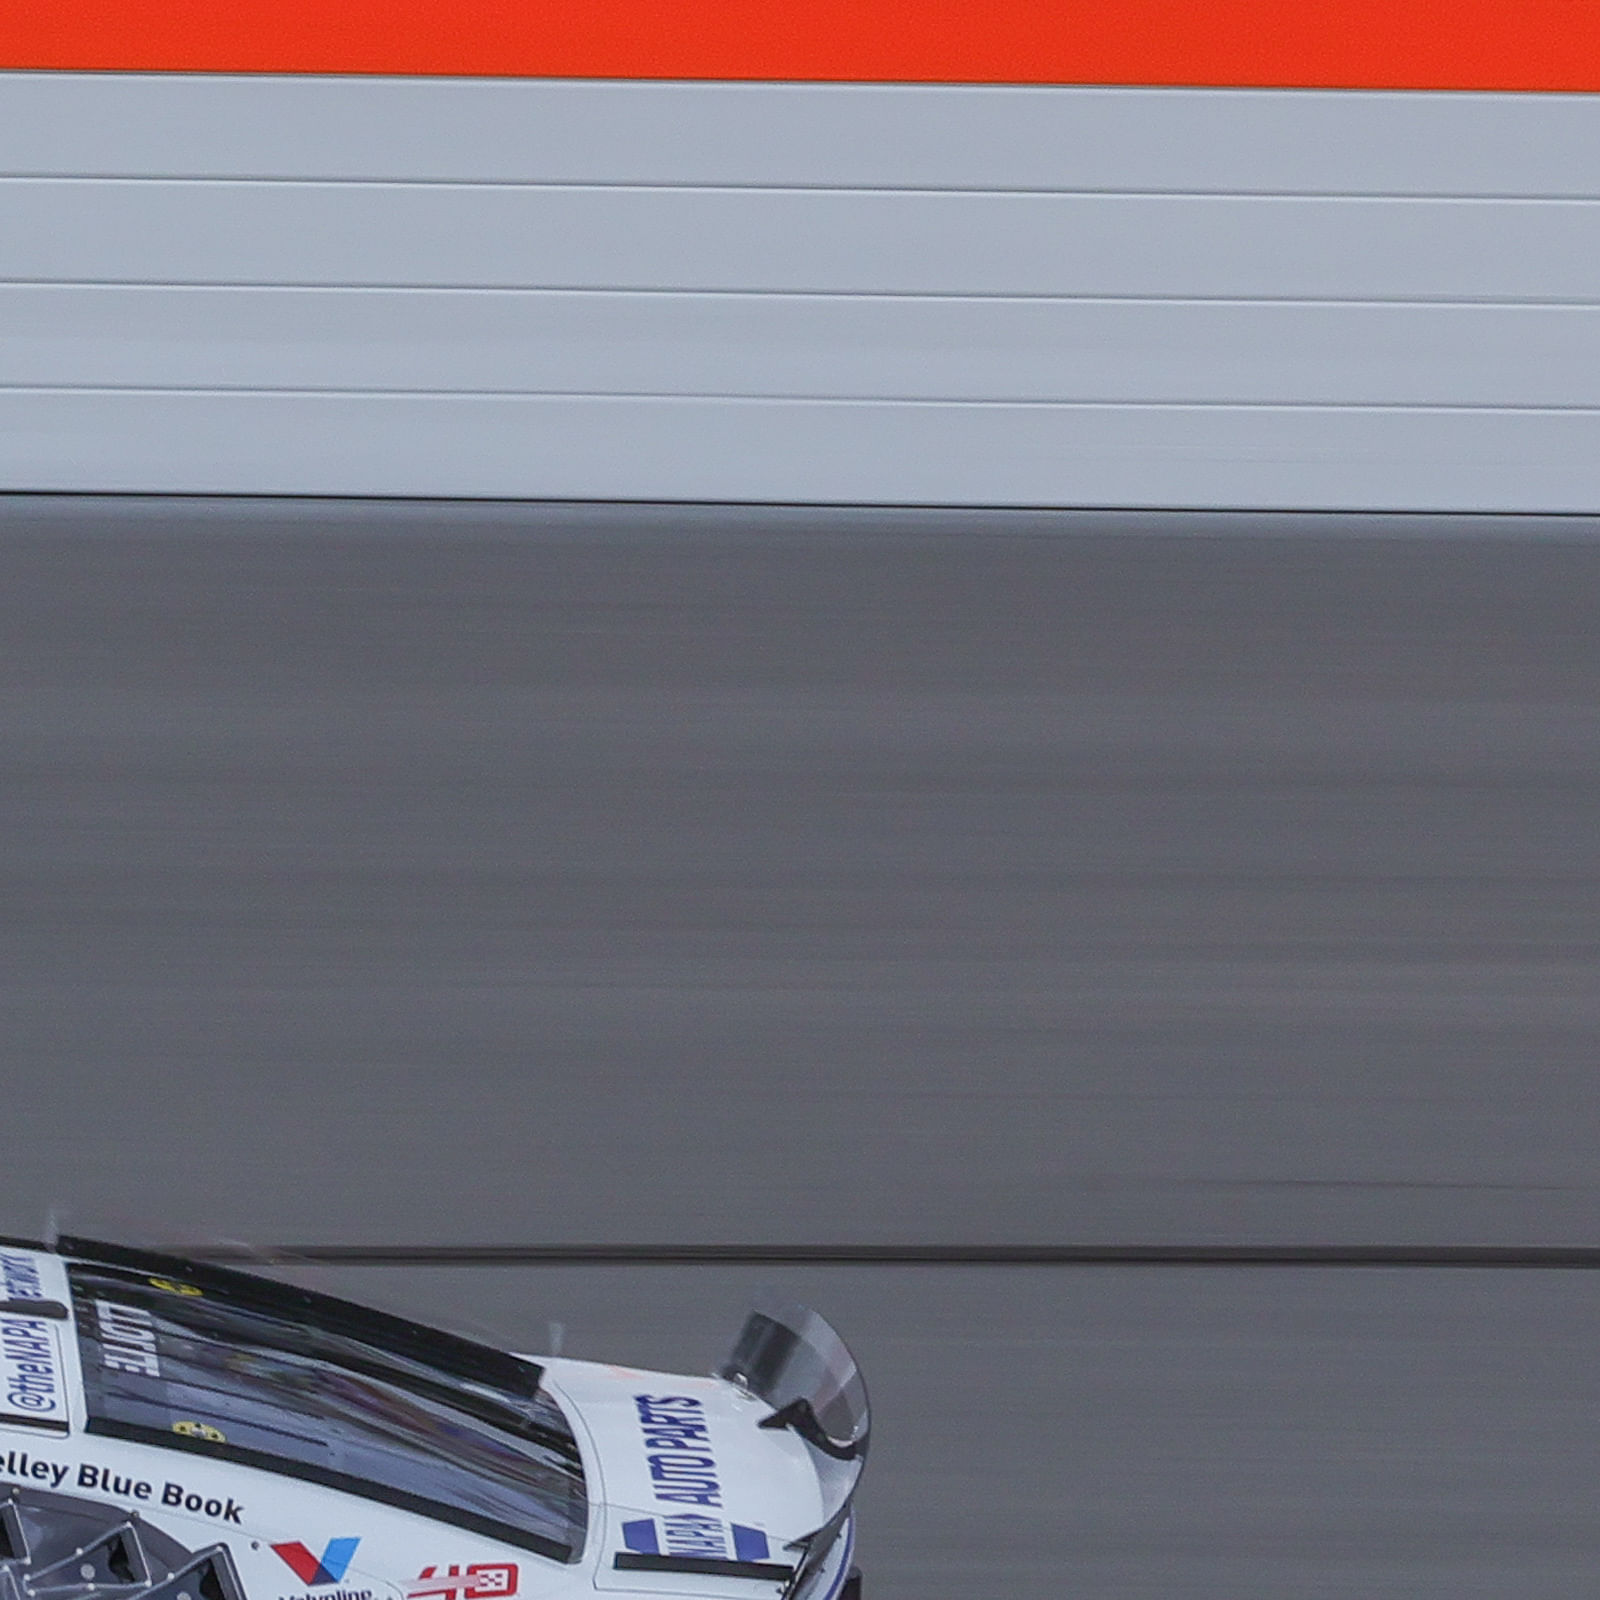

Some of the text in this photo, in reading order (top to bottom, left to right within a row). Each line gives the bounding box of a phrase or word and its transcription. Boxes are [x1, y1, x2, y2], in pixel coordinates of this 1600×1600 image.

[634, 1394, 712, 1453] PARTS
[76, 1464, 153, 1500] Blue
[161, 1482, 246, 1525] Book
[647, 1453, 723, 1508] AUTO
